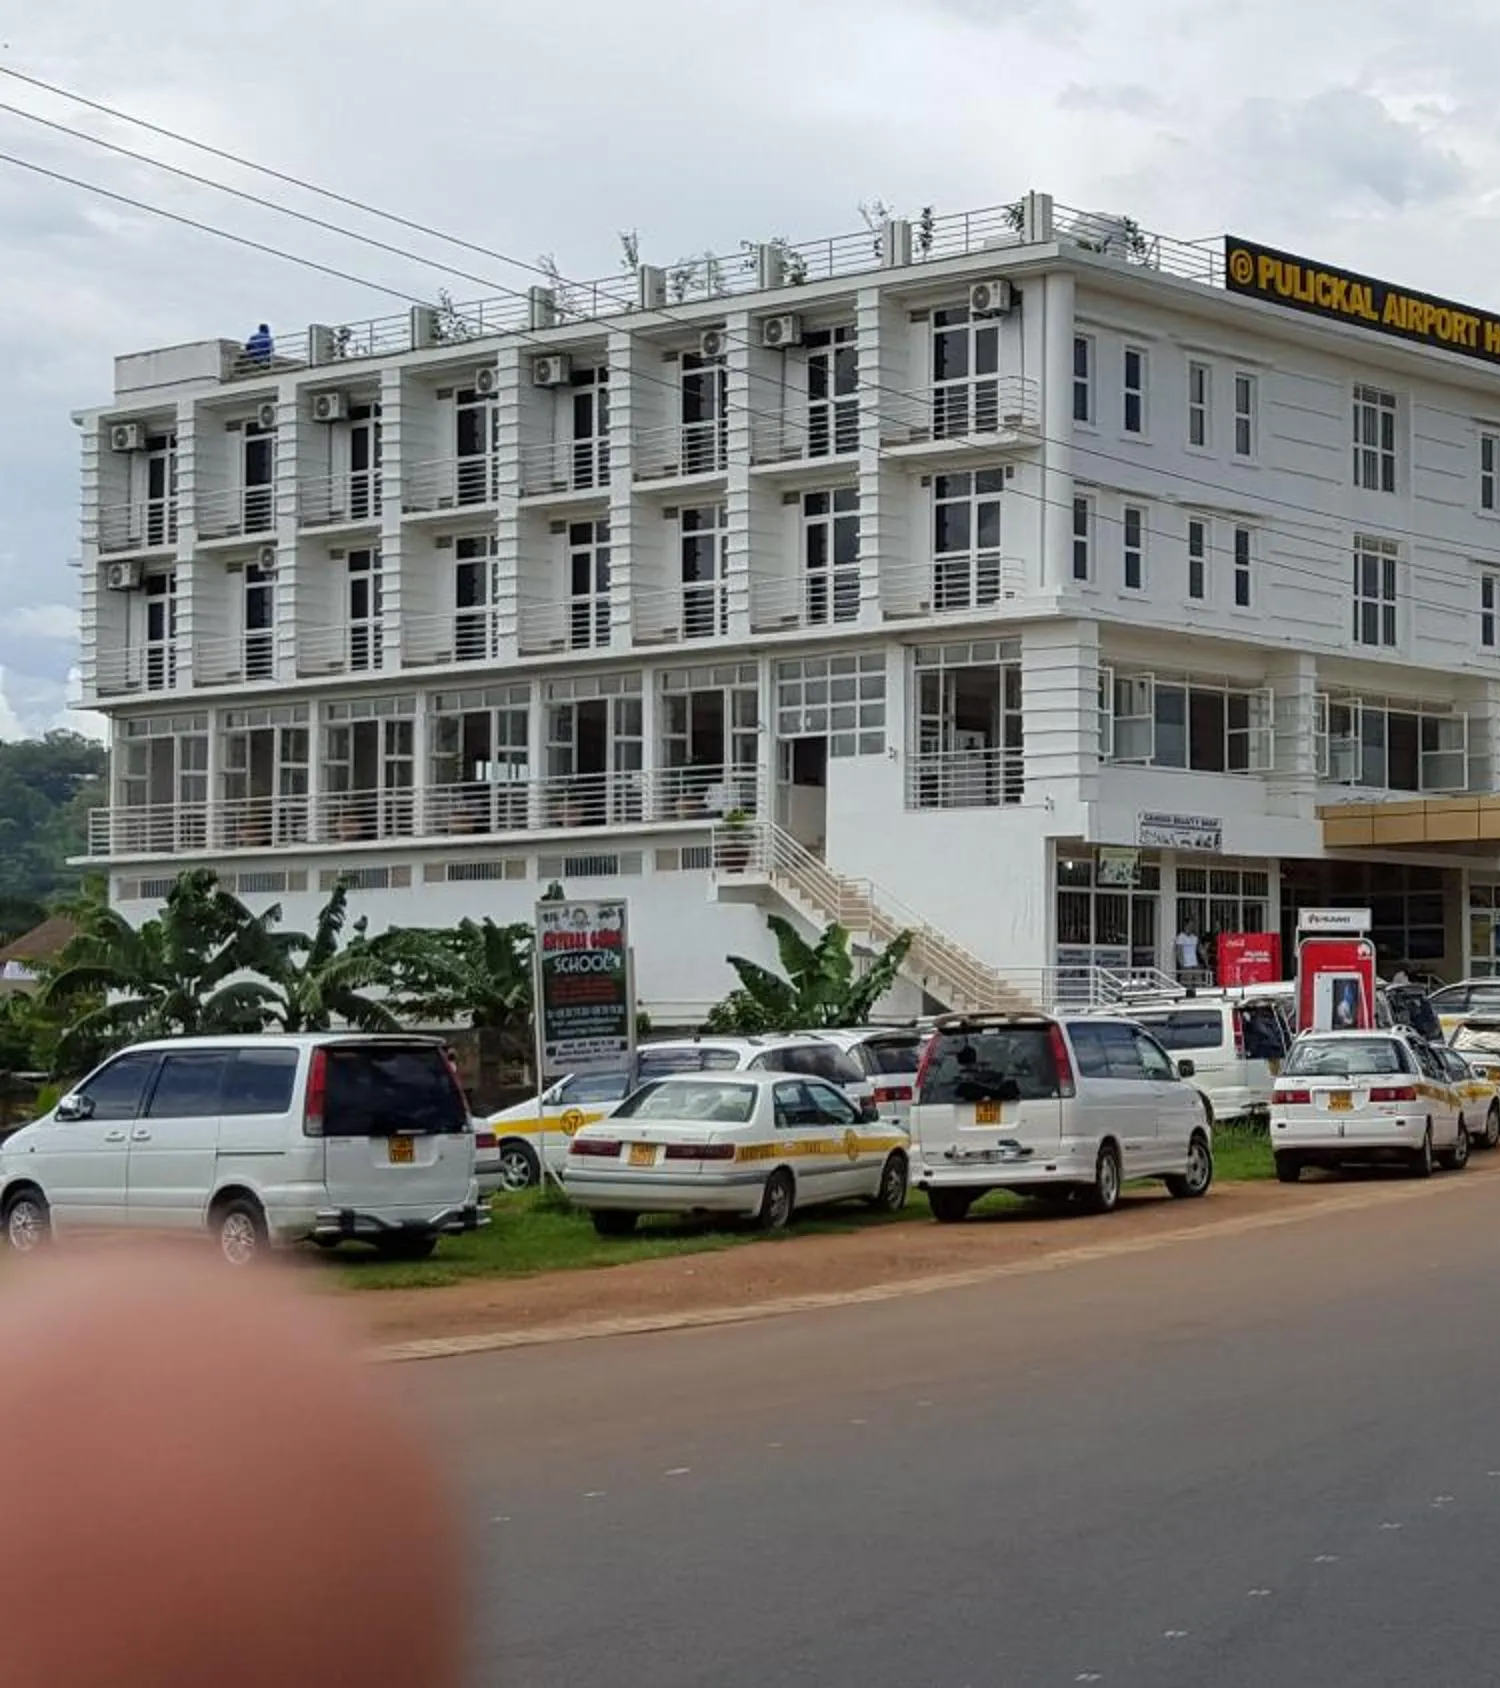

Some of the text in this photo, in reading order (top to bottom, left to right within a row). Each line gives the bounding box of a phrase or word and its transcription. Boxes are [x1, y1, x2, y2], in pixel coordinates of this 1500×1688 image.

[1257, 254, 1379, 322] PULICKAL
[1383, 291, 1480, 348] AIRPORT
[553, 952, 615, 975] SCHOOL
